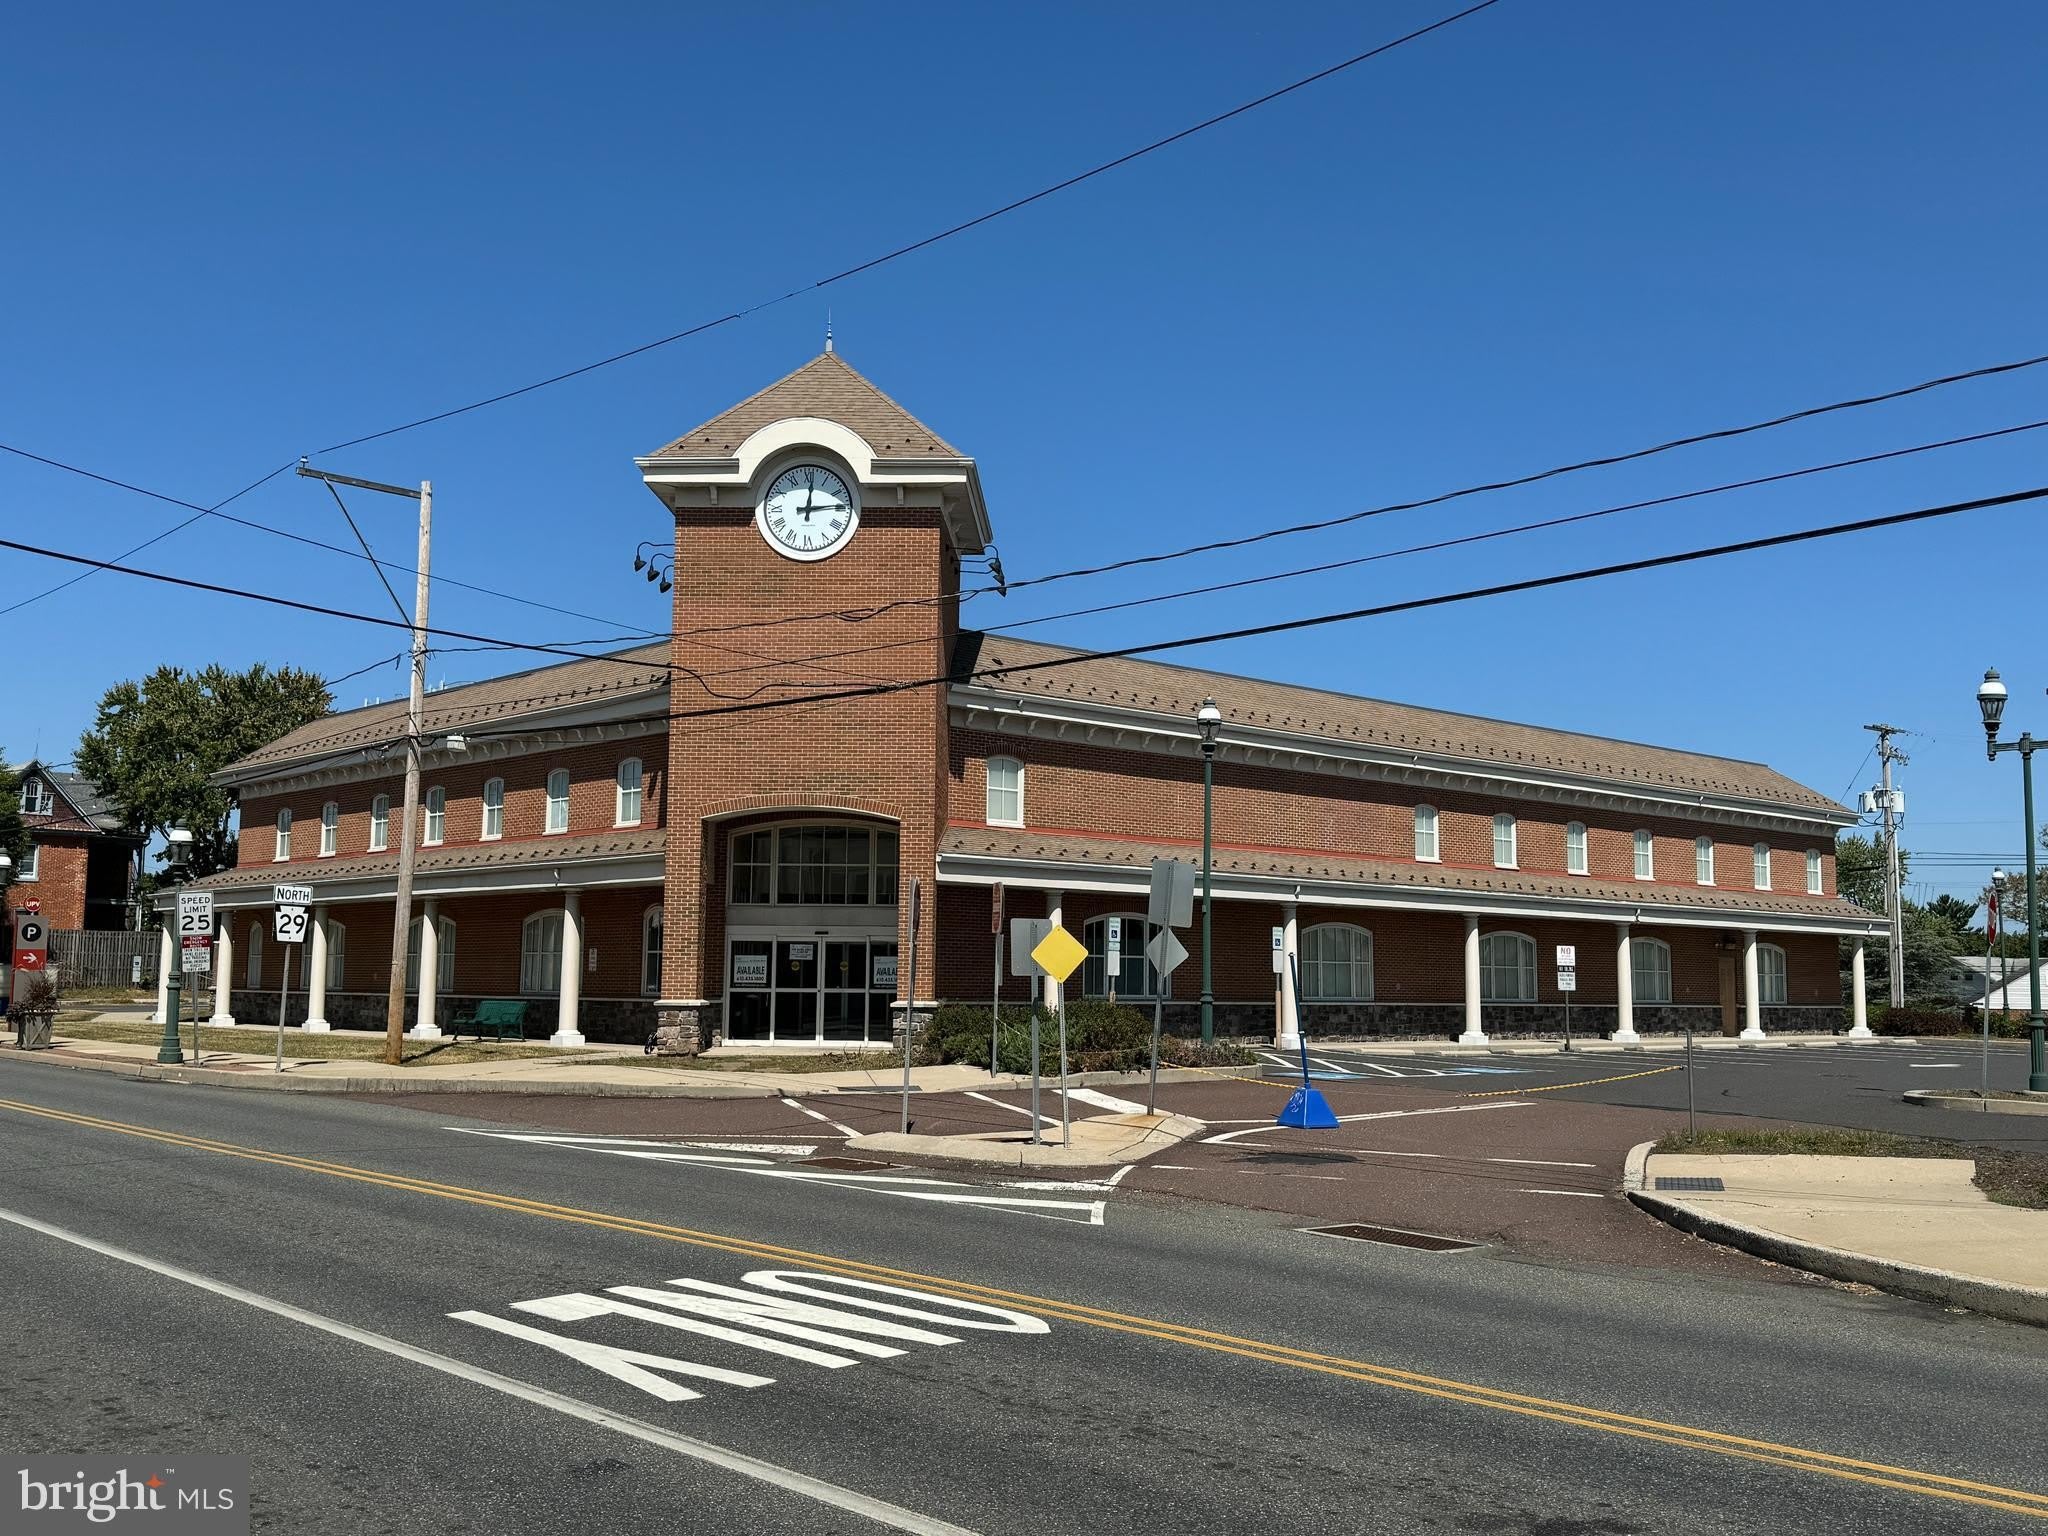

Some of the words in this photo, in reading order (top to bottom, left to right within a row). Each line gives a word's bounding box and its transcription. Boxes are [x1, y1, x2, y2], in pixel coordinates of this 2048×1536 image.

[181, 896, 211, 904] SPEED
[277, 887, 310, 901] NORTH
[184, 905, 207, 913] LIMIT
[182, 914, 210, 931] 25
[279, 914, 305, 934] 29
[27, 927, 37, 939] P
[736, 966, 765, 975] AVAILABLE
[876, 967, 897, 976] AVAILA
[444, 1270, 1051, 1402] ONLY
